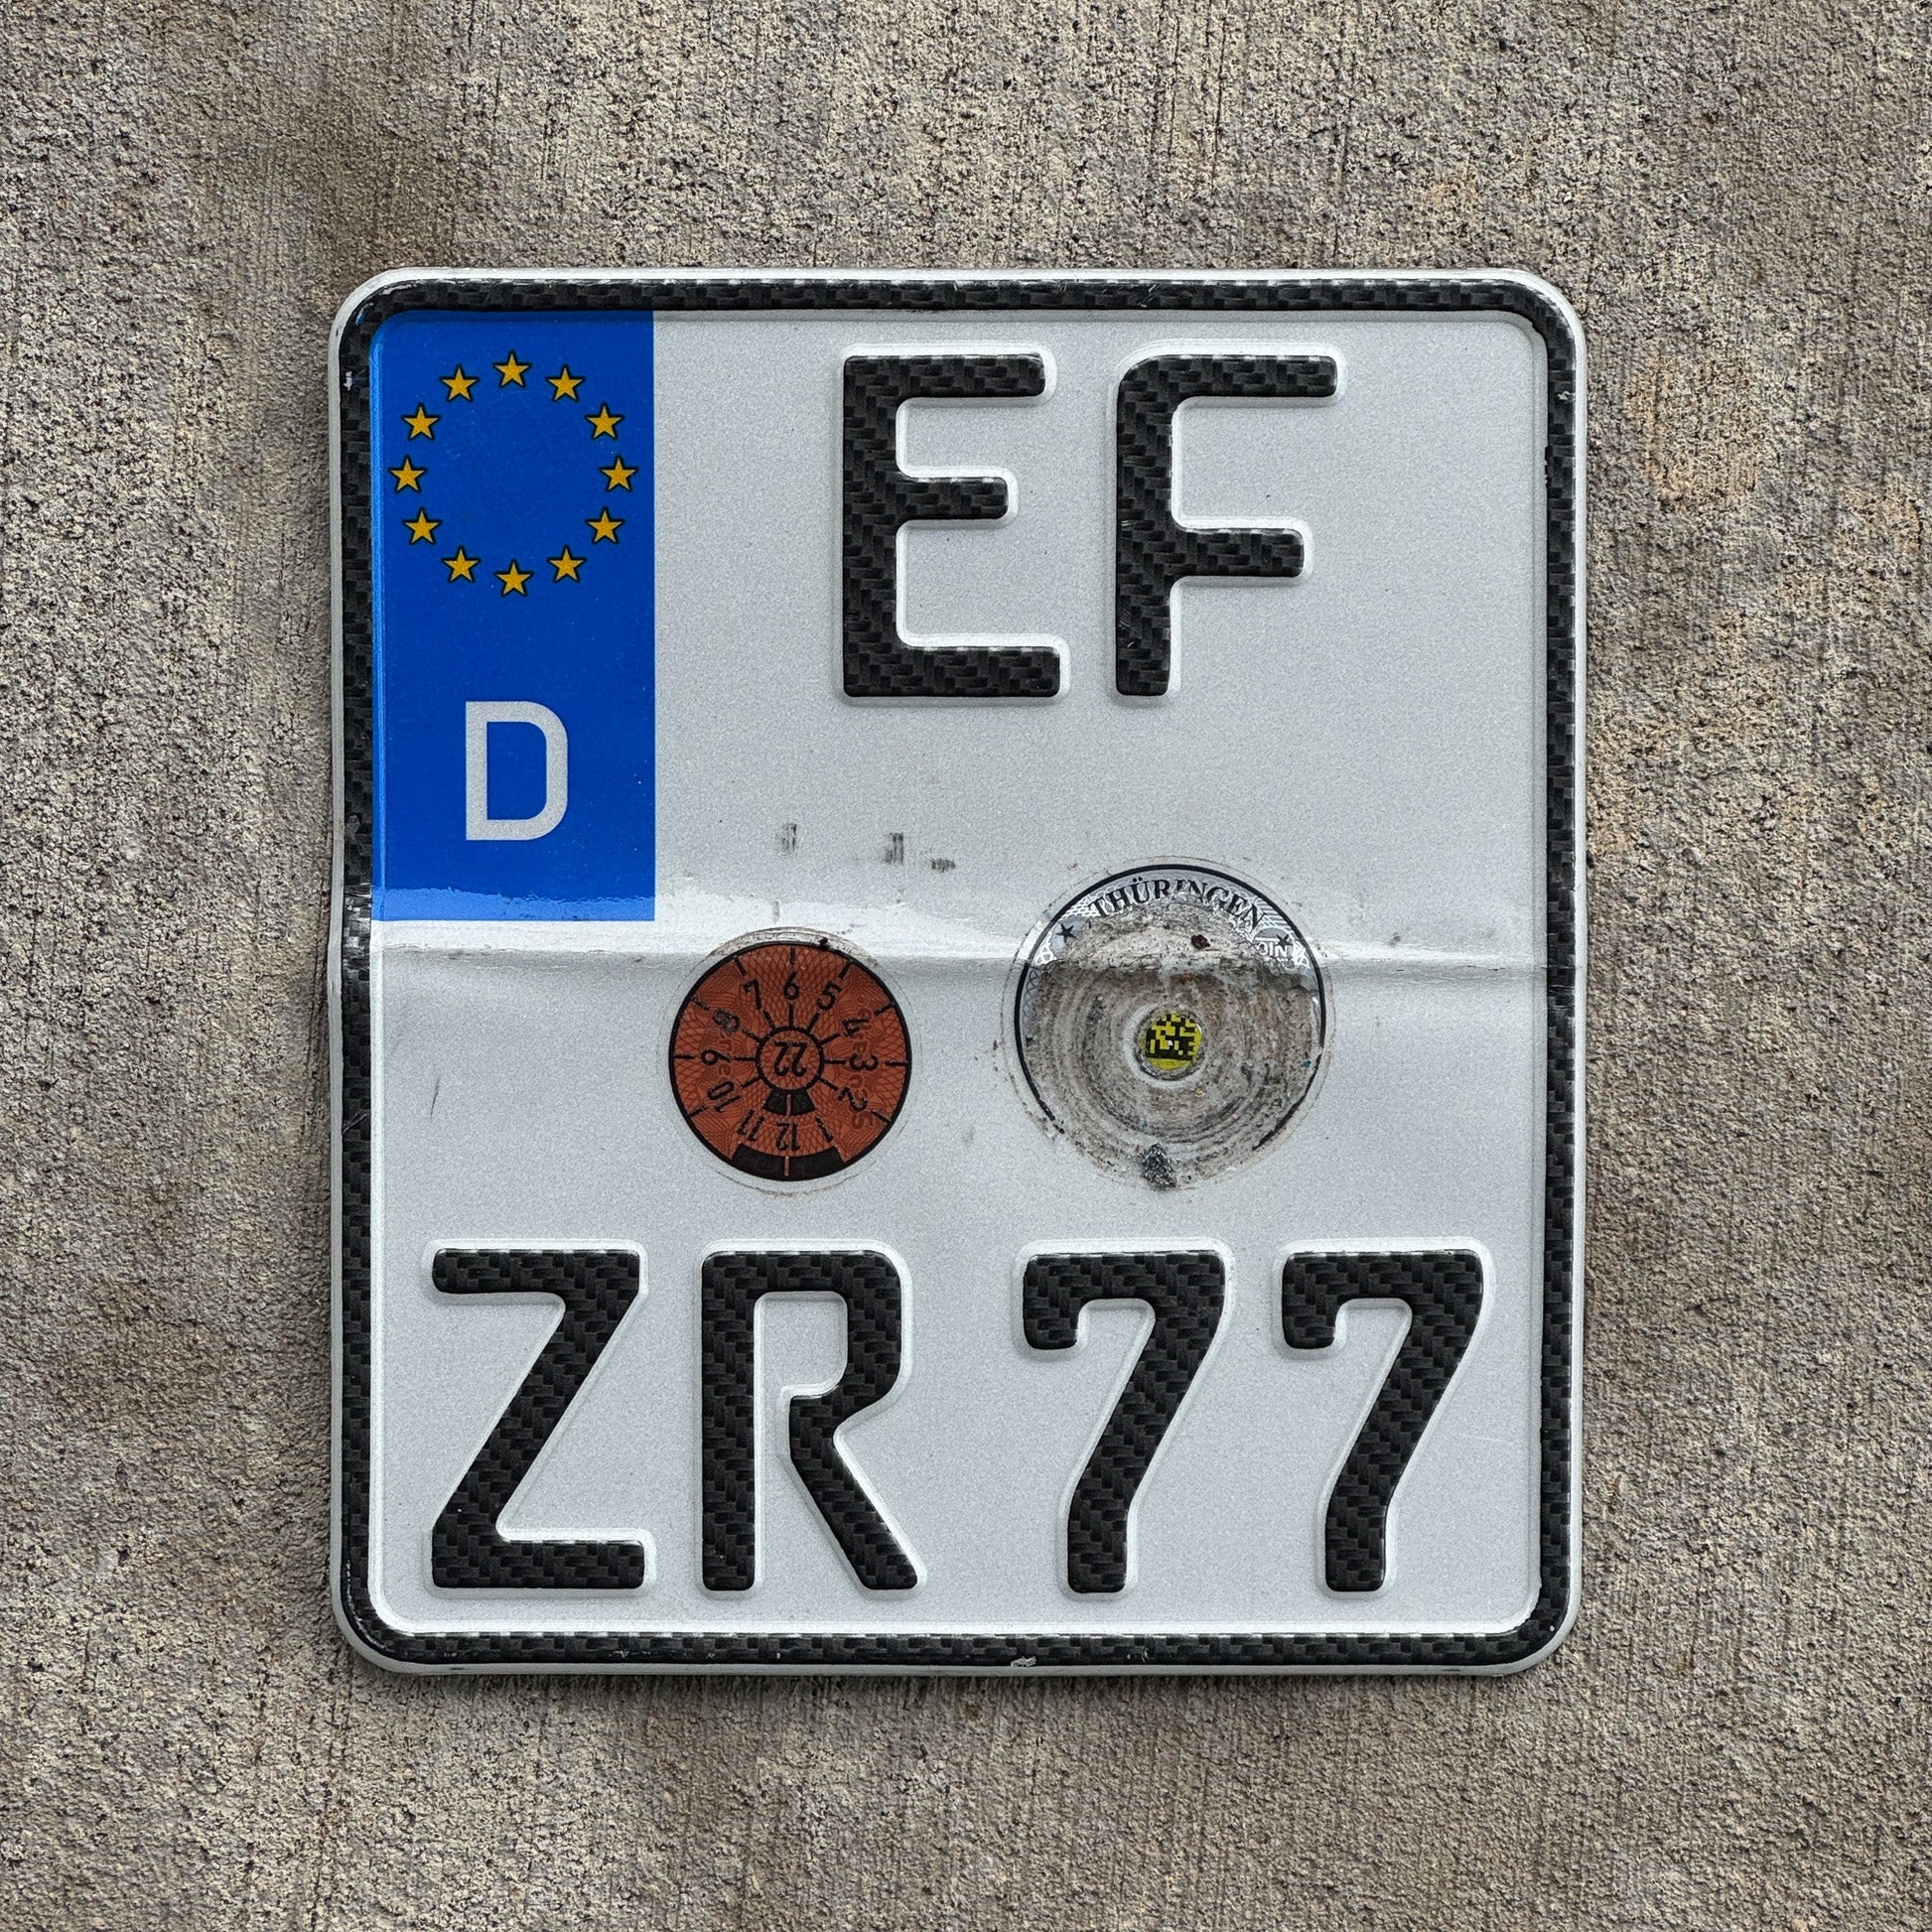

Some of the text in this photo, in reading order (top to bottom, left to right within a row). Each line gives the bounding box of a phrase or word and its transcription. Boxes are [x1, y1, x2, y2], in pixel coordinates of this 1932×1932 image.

[842, 353, 1337, 697] EF
[466, 701, 568, 841] D
[744, 979, 761, 1010] 7
[783, 974, 799, 1000] 6
[817, 981, 842, 1010] 5
[712, 1008, 740, 1033] 8
[842, 1019, 870, 1037] 4
[701, 1049, 732, 1066] 9
[774, 1041, 807, 1077] 22
[850, 1054, 879, 1071] 3
[707, 1081, 741, 1113] 10
[838, 1087, 868, 1112] 2
[738, 1109, 764, 1142] 11
[776, 1123, 800, 1151] 12
[815, 1116, 833, 1142] 1
[432, 1249, 1483, 1592] ZR 77
